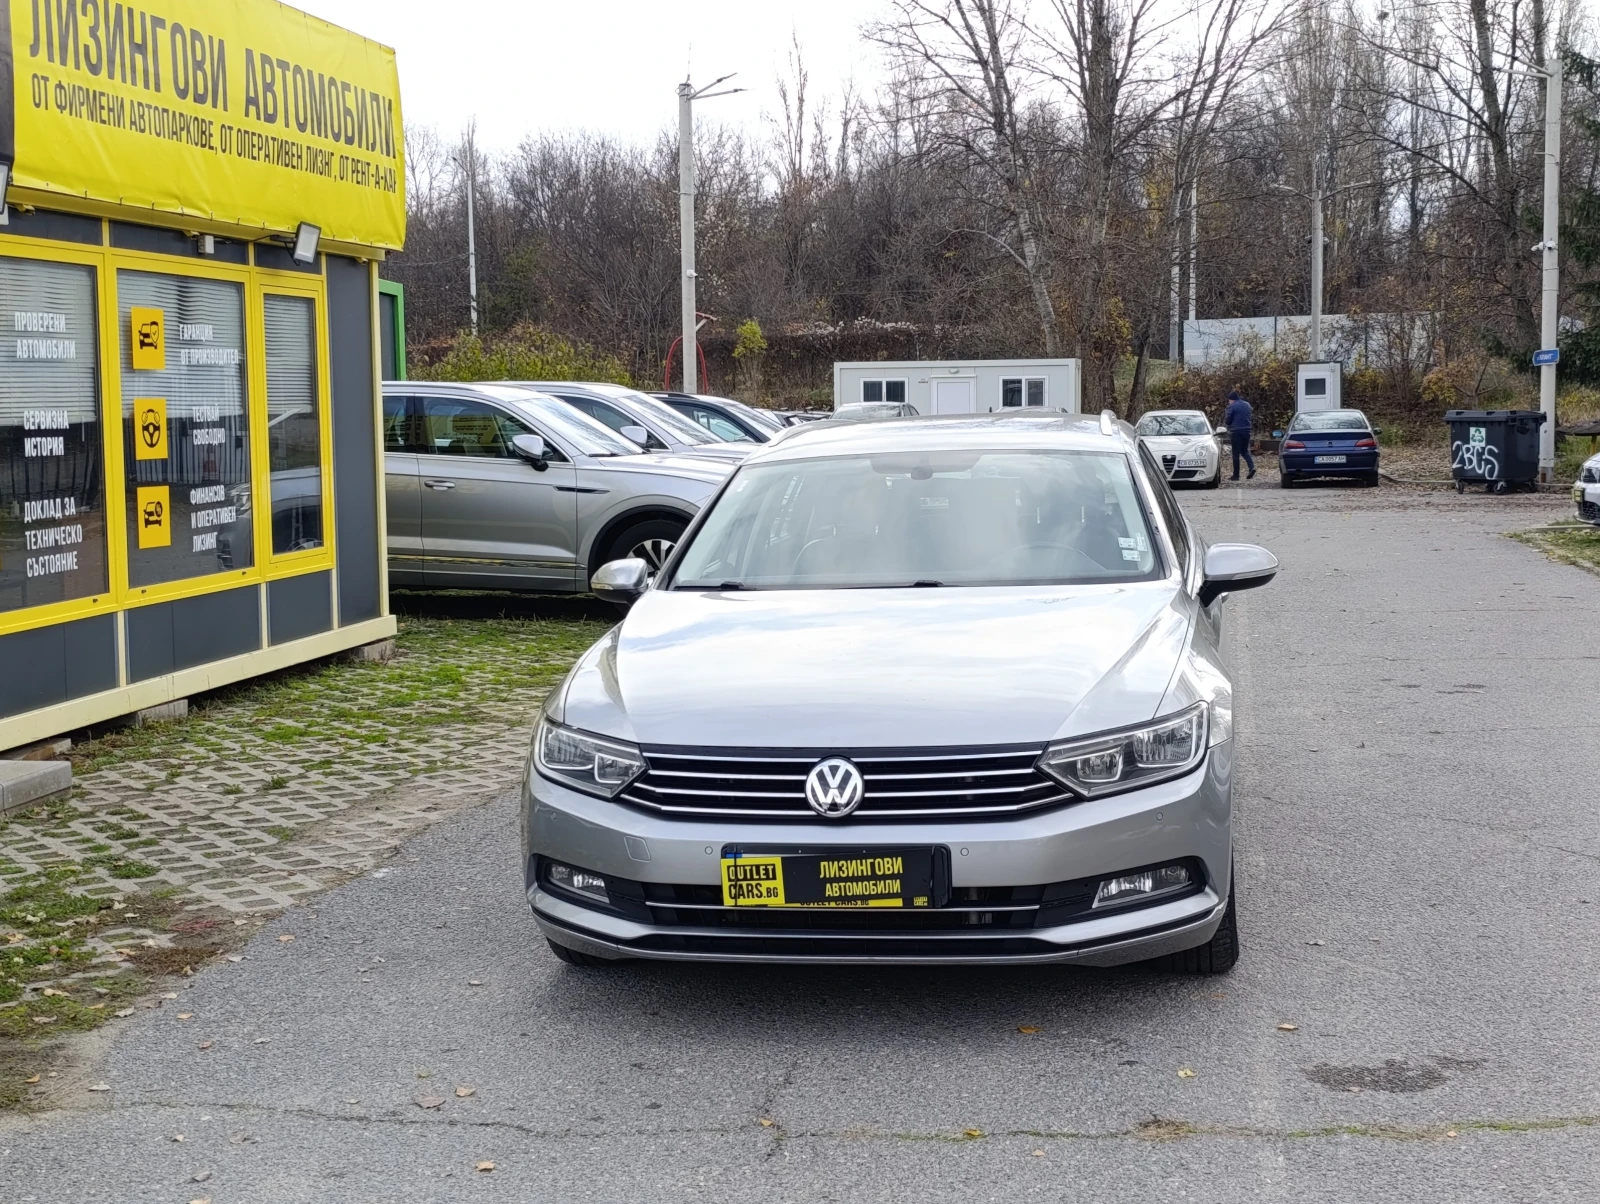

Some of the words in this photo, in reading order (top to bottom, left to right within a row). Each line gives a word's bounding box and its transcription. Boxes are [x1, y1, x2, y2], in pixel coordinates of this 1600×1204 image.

[29, 0, 228, 112] ЛИЗИНГОВИ
[244, 48, 397, 159] АВТОМОБИЛИ
[31, 73, 50, 111] ОТ
[54, 80, 126, 129] ФИРМЕНИ
[129, 99, 218, 155] АВТОПАРКОВЕ,
[220, 123, 234, 155] ОТ
[236, 128, 303, 171] ОПЕРАТИВЕН
[339, 154, 350, 182] ОТ
[14, 311, 67, 332] ПРОВЕРЕНИ
[179, 324, 214, 342] ГАРАНЦИЯ
[16, 339, 76, 359] АВТОМОБИЛИ
[181, 348, 190, 365] ОТ
[190, 348, 239, 366] ПРОИЗВОДИТЕЛ
[23, 410, 69, 430] СЕРВИЗНА
[192, 403, 220, 422] ТЕСТВАЙ
[24, 436, 65, 457] ИСТОРИЯ
[192, 427, 226, 446] СВОБОДНО
[189, 485, 225, 505] ФИНАНСОВ
[24, 498, 63, 524] ДОКЛАД
[63, 497, 76, 517] ЗА
[190, 512, 197, 529] И
[197, 506, 237, 528] ОПЕРАТИВЕН
[25, 524, 83, 550] ТЕХНИЧЕСКО
[192, 532, 218, 552] ЛИЗИНГ
[26, 551, 79, 578] СЪСТОЯНИЕ
[729, 865, 774, 880] OUTLET
[819, 857, 903, 878] ЛИЗИНГОВИ
[728, 882, 779, 900] CARS.BG
[825, 879, 901, 897] АВТОМОБИЛИ
